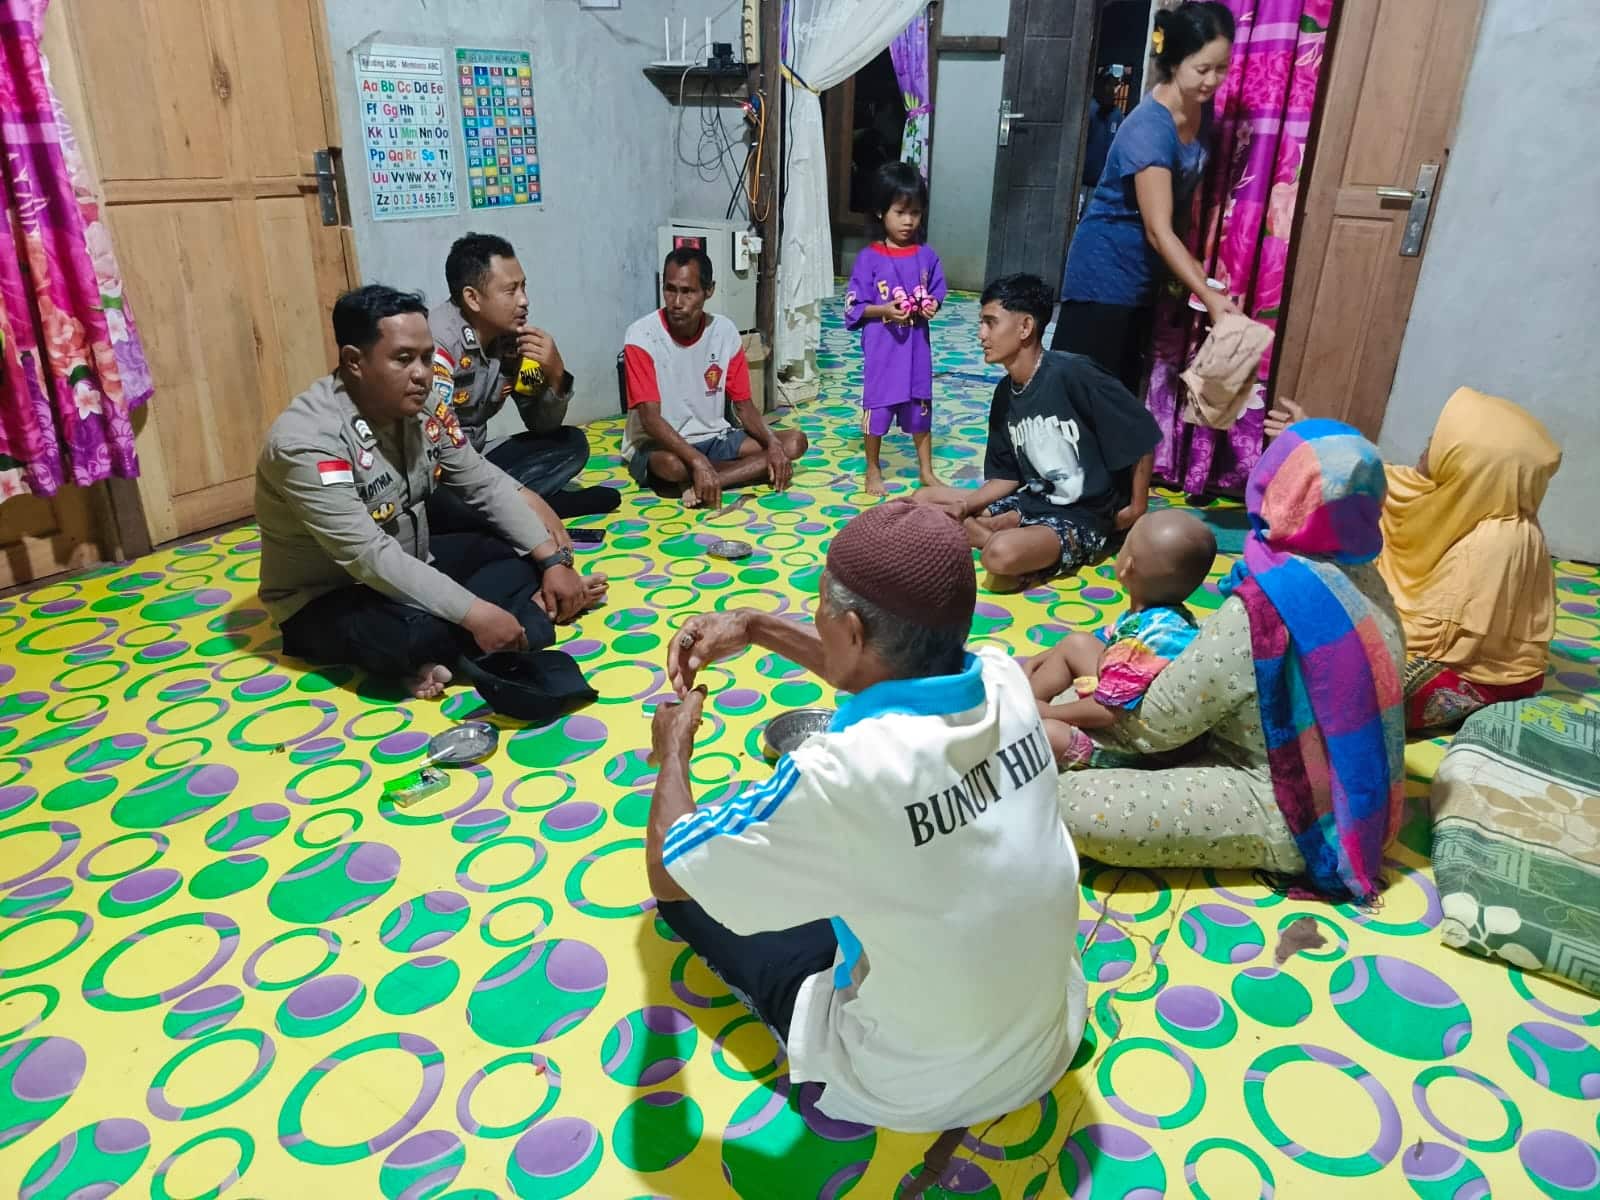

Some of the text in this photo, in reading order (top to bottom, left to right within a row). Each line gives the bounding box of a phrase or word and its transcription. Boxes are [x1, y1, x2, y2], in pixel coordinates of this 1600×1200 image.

[363, 80, 443, 94] Aa Bb Cc Dd Ee
[367, 103, 377, 115] Ff
[383, 104, 398, 118] Gg
[400, 104, 414, 116] Hh
[435, 105, 444, 118] Jj
[368, 126, 448, 138] Kk Ll Mm Nn Oo
[370, 149, 448, 162] Pp Qq Rr Ss Tt
[373, 170, 452, 183] Uu Vv Ww Xx Yy
[377, 194, 390, 205] Zz
[877, 280, 889, 300] 5
[904, 759, 1002, 847] BUNUT
